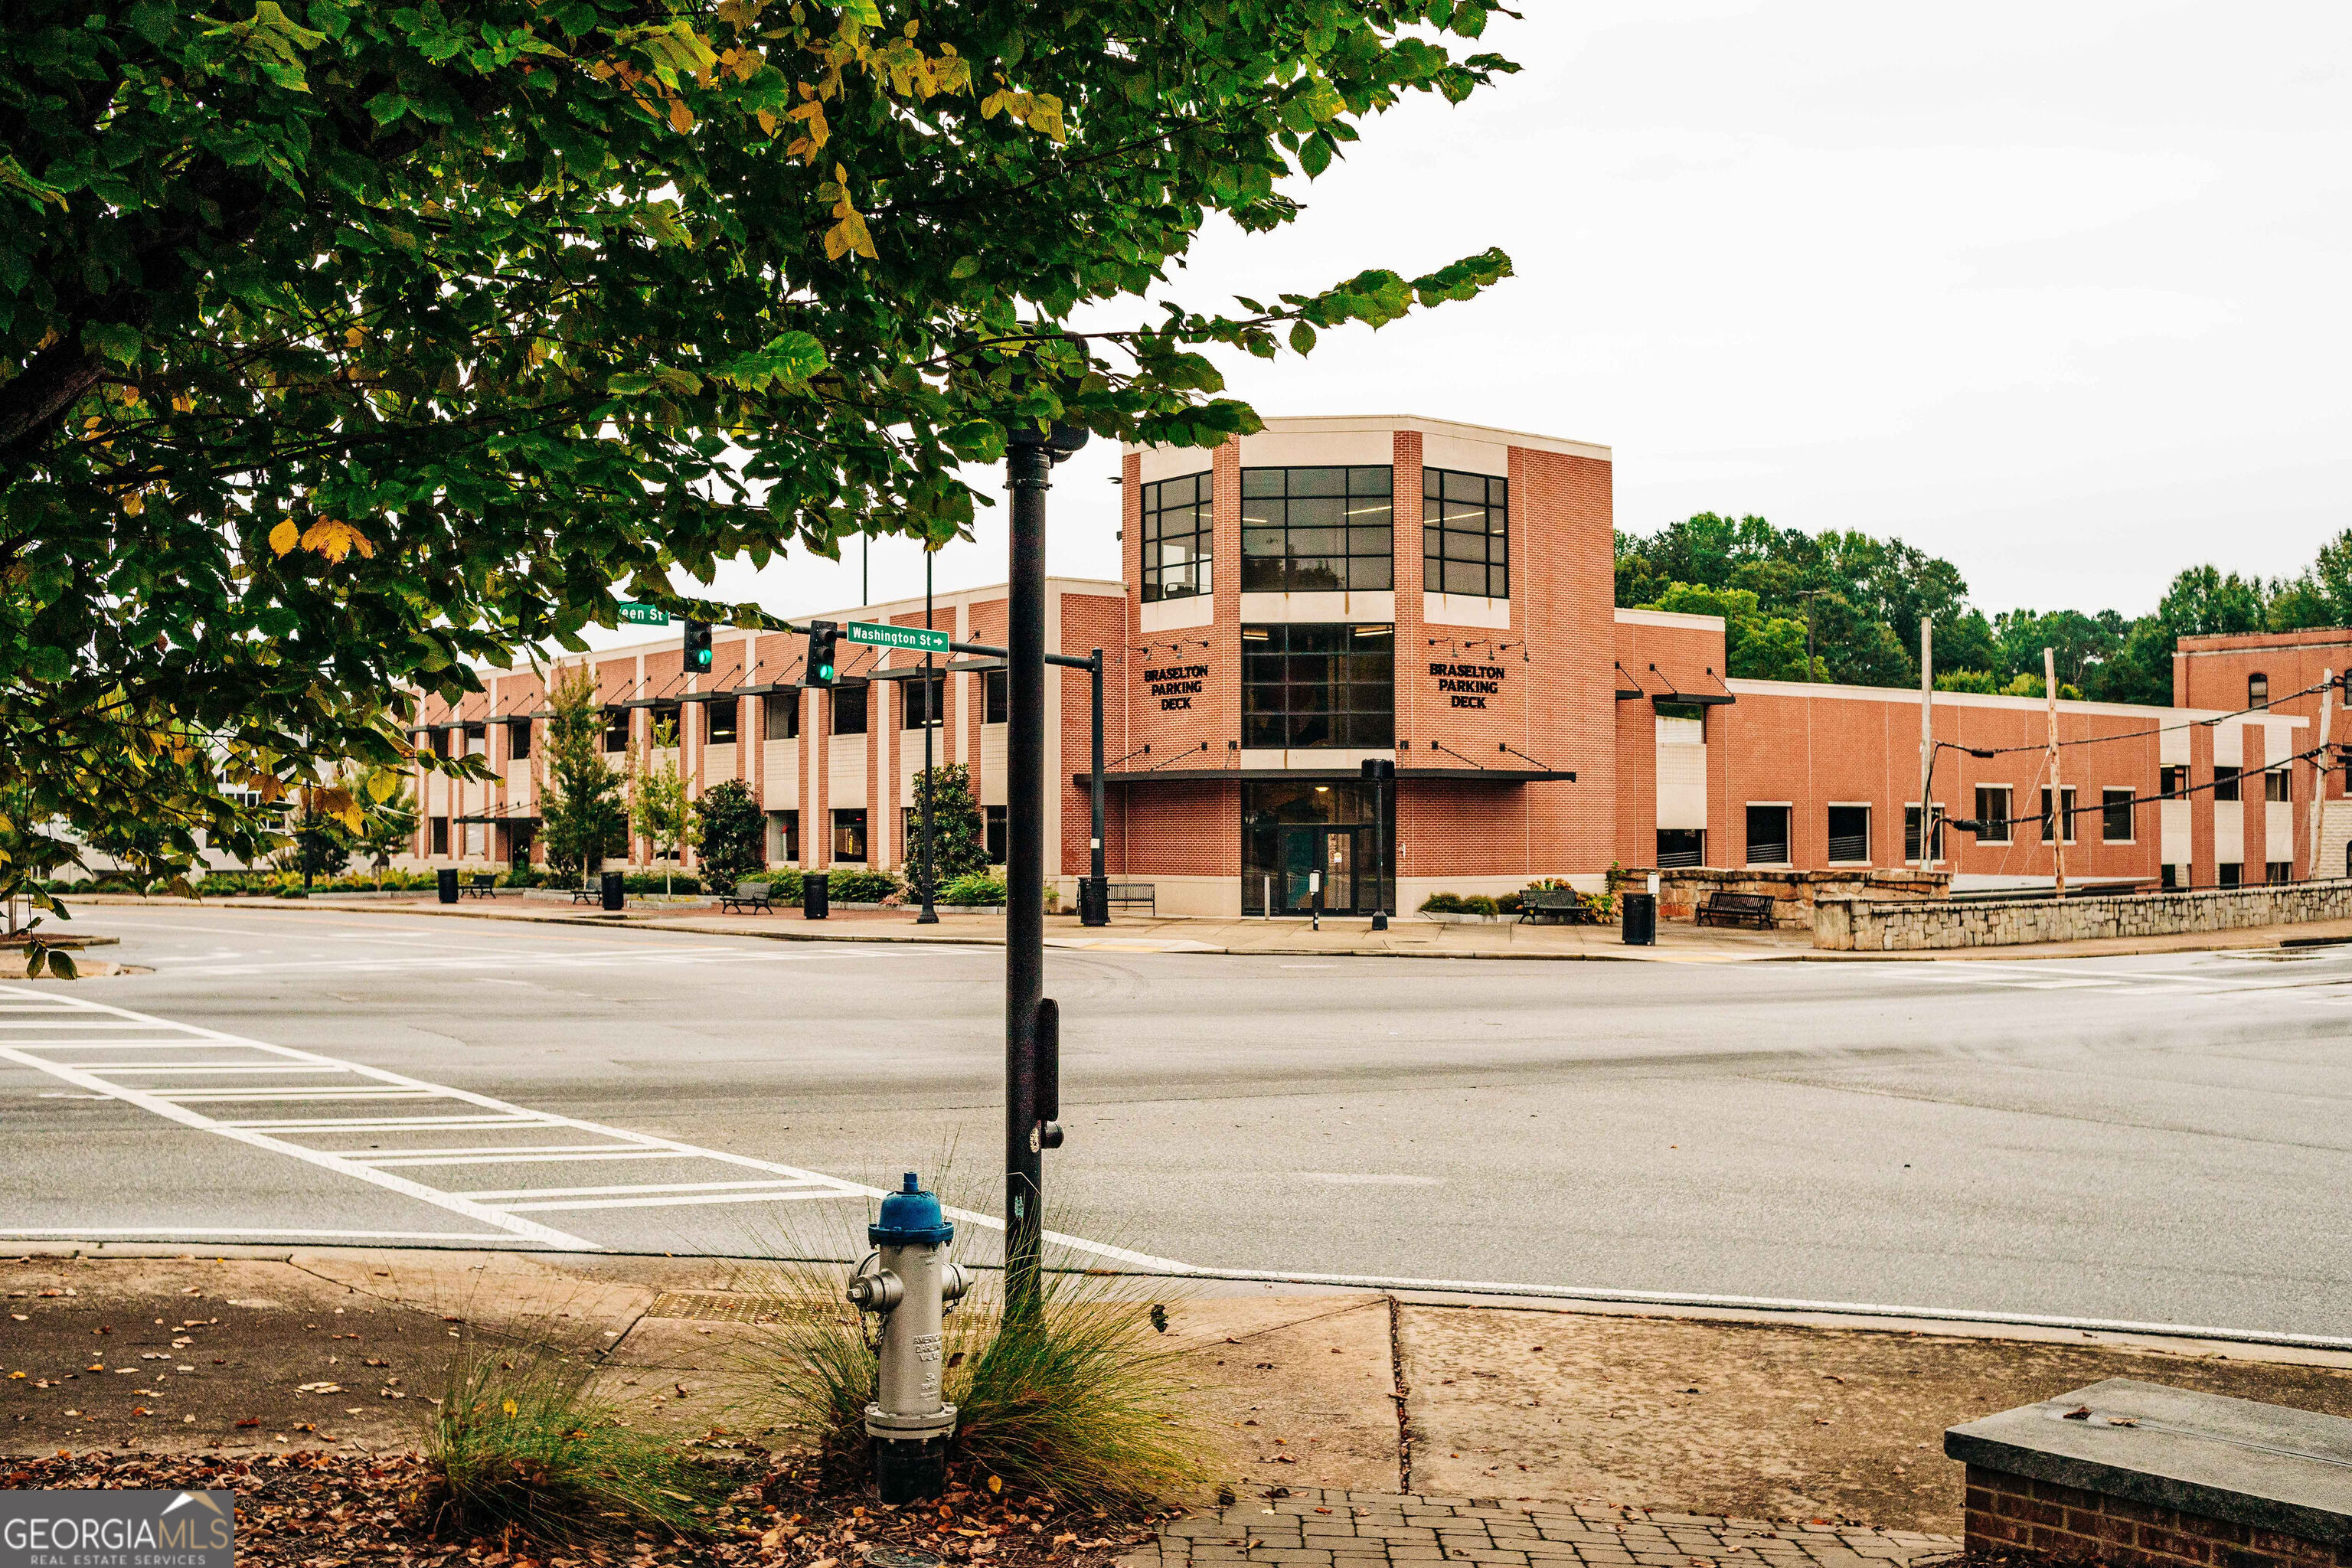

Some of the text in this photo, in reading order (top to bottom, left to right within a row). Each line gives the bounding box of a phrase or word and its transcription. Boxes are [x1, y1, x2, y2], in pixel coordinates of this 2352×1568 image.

[619, 608, 664, 621] een St
[852, 626, 932, 646] Washington St
[1144, 665, 1209, 681] BRASELTON
[1429, 663, 1505, 680] BRASELTON
[1152, 680, 1202, 696] PARKING
[1439, 678, 1498, 694] PARKING
[1161, 697, 1192, 710] DECK
[1451, 695, 1487, 709] DECK
